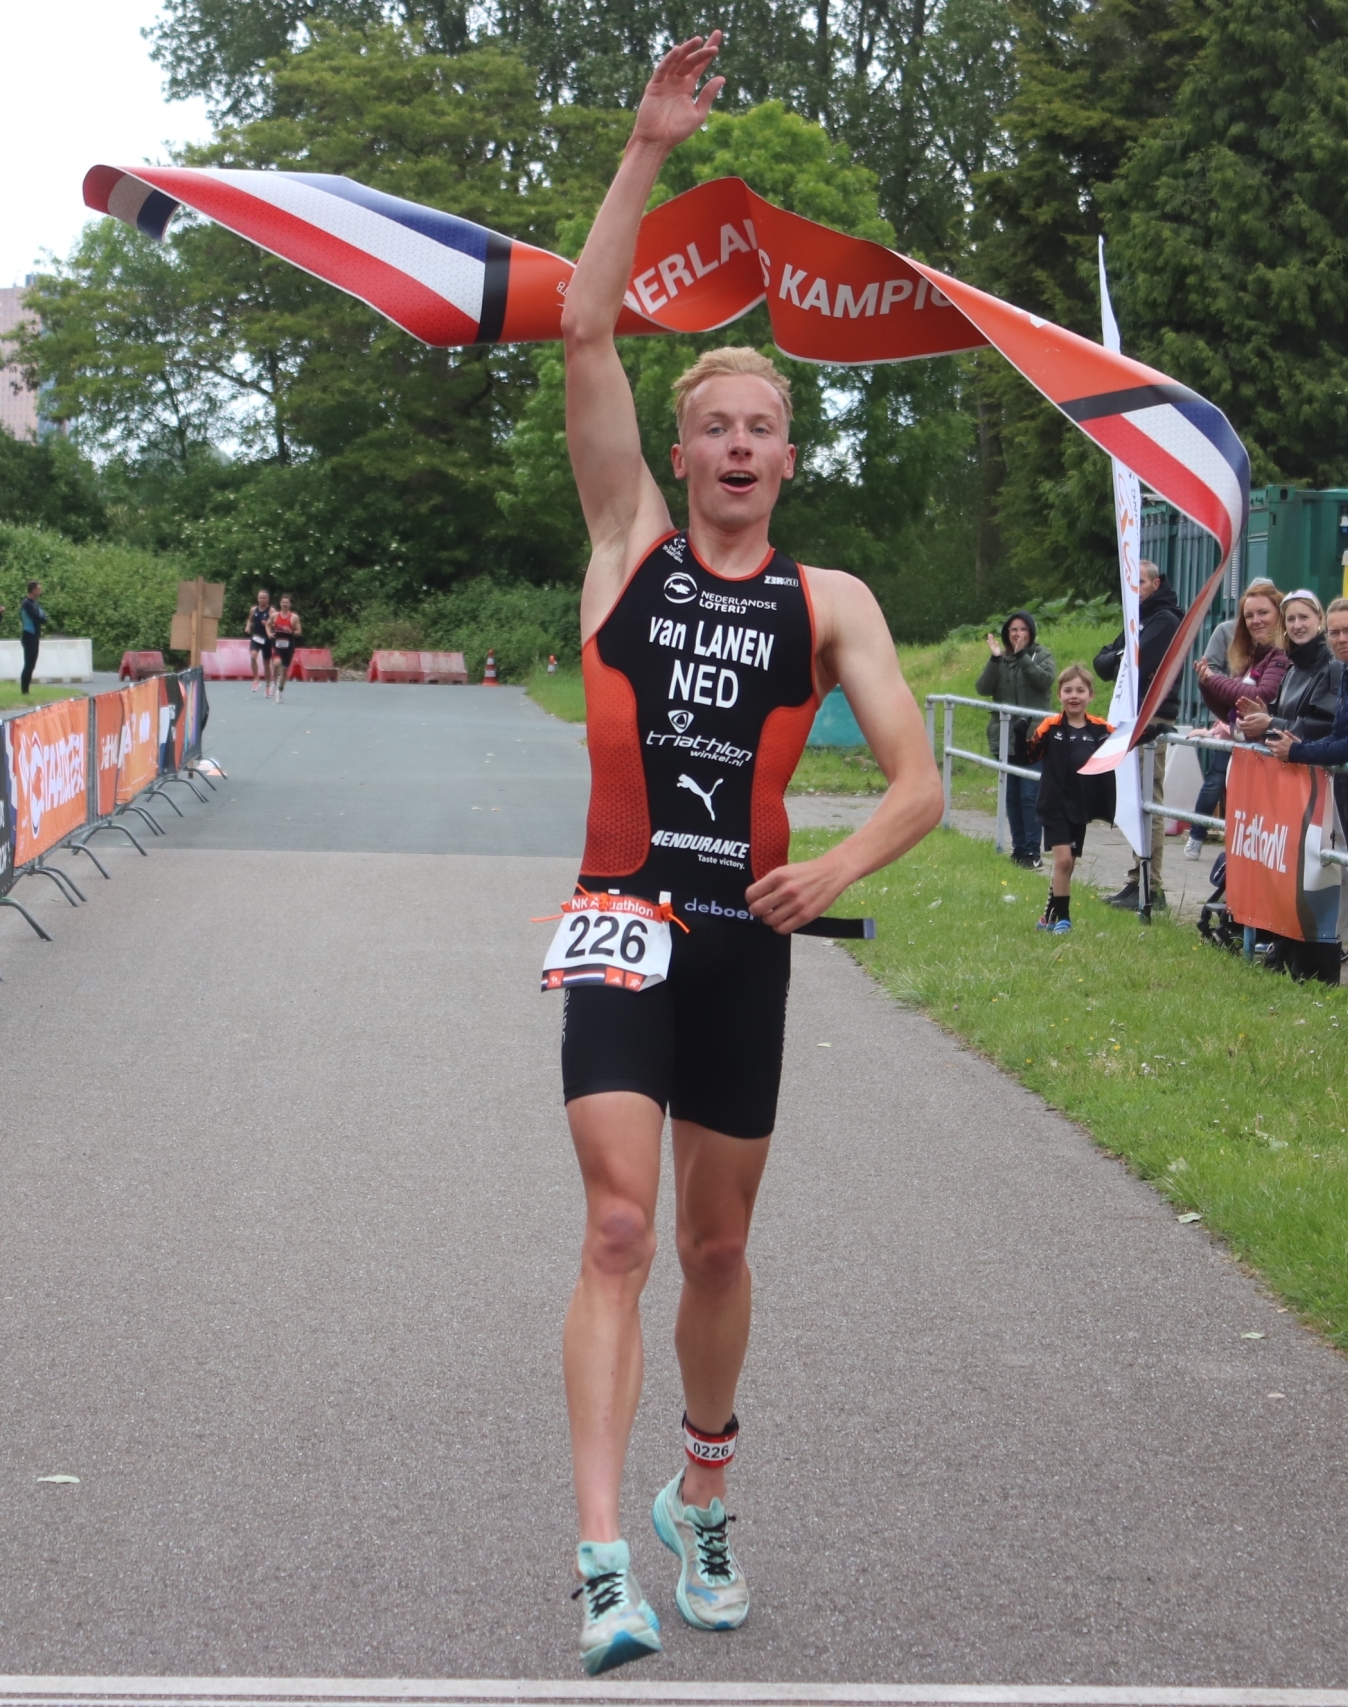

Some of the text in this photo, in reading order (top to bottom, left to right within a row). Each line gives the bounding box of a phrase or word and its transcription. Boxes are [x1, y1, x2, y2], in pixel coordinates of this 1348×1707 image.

[699, 598, 747, 615] LOTERIJ
[701, 590, 778, 611] NEDERLANDSE
[649, 616, 775, 671] van LANEN
[668, 659, 739, 709] NED
[646, 730, 753, 762] triathlon
[690, 750, 744, 767] winkel.nl
[651, 830, 750, 859] 4ENDURANCE
[697, 854, 745, 870] Taste victory.
[571, 897, 654, 918] NK Auathlon
[565, 915, 648, 964] 226
[693, 1442, 729, 1459] 0226
